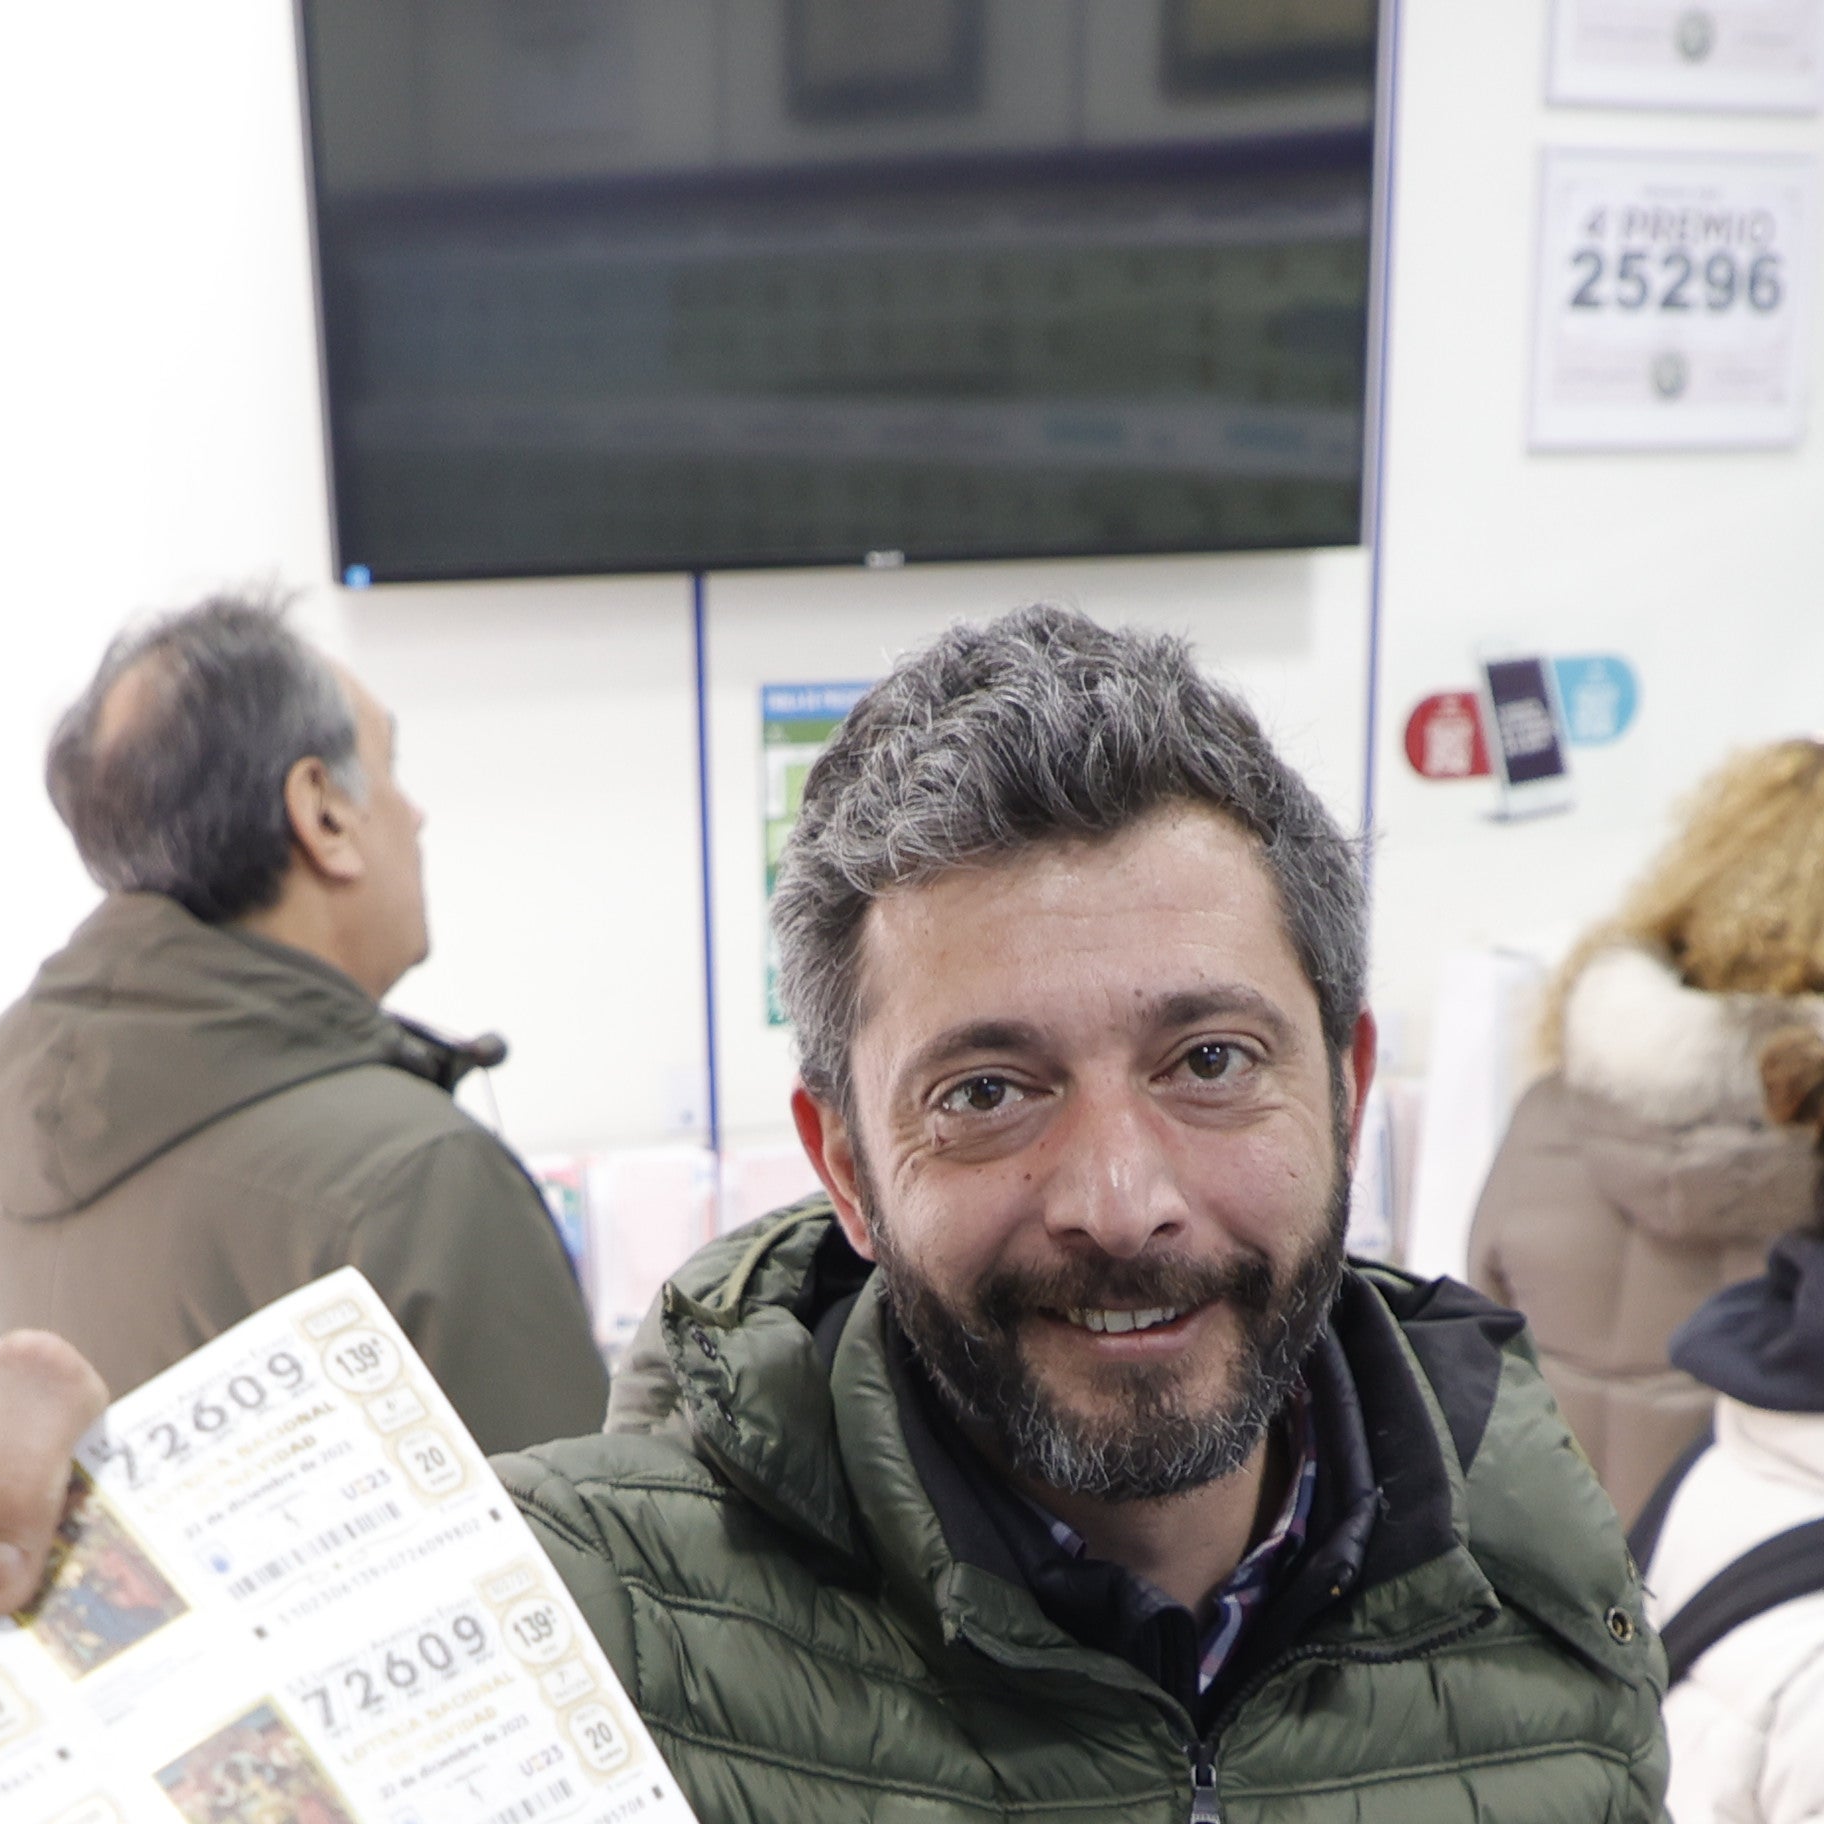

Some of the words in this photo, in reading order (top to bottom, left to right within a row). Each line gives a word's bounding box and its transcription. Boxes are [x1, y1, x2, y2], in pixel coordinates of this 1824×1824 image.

[1568, 248, 1785, 311] 25296
[107, 1352, 306, 1481] 72609
[413, 1445, 446, 1474] 20
[301, 1614, 486, 1728] 72609
[424, 1671, 515, 1721] NACIONAL
[583, 1721, 613, 1751] 20
